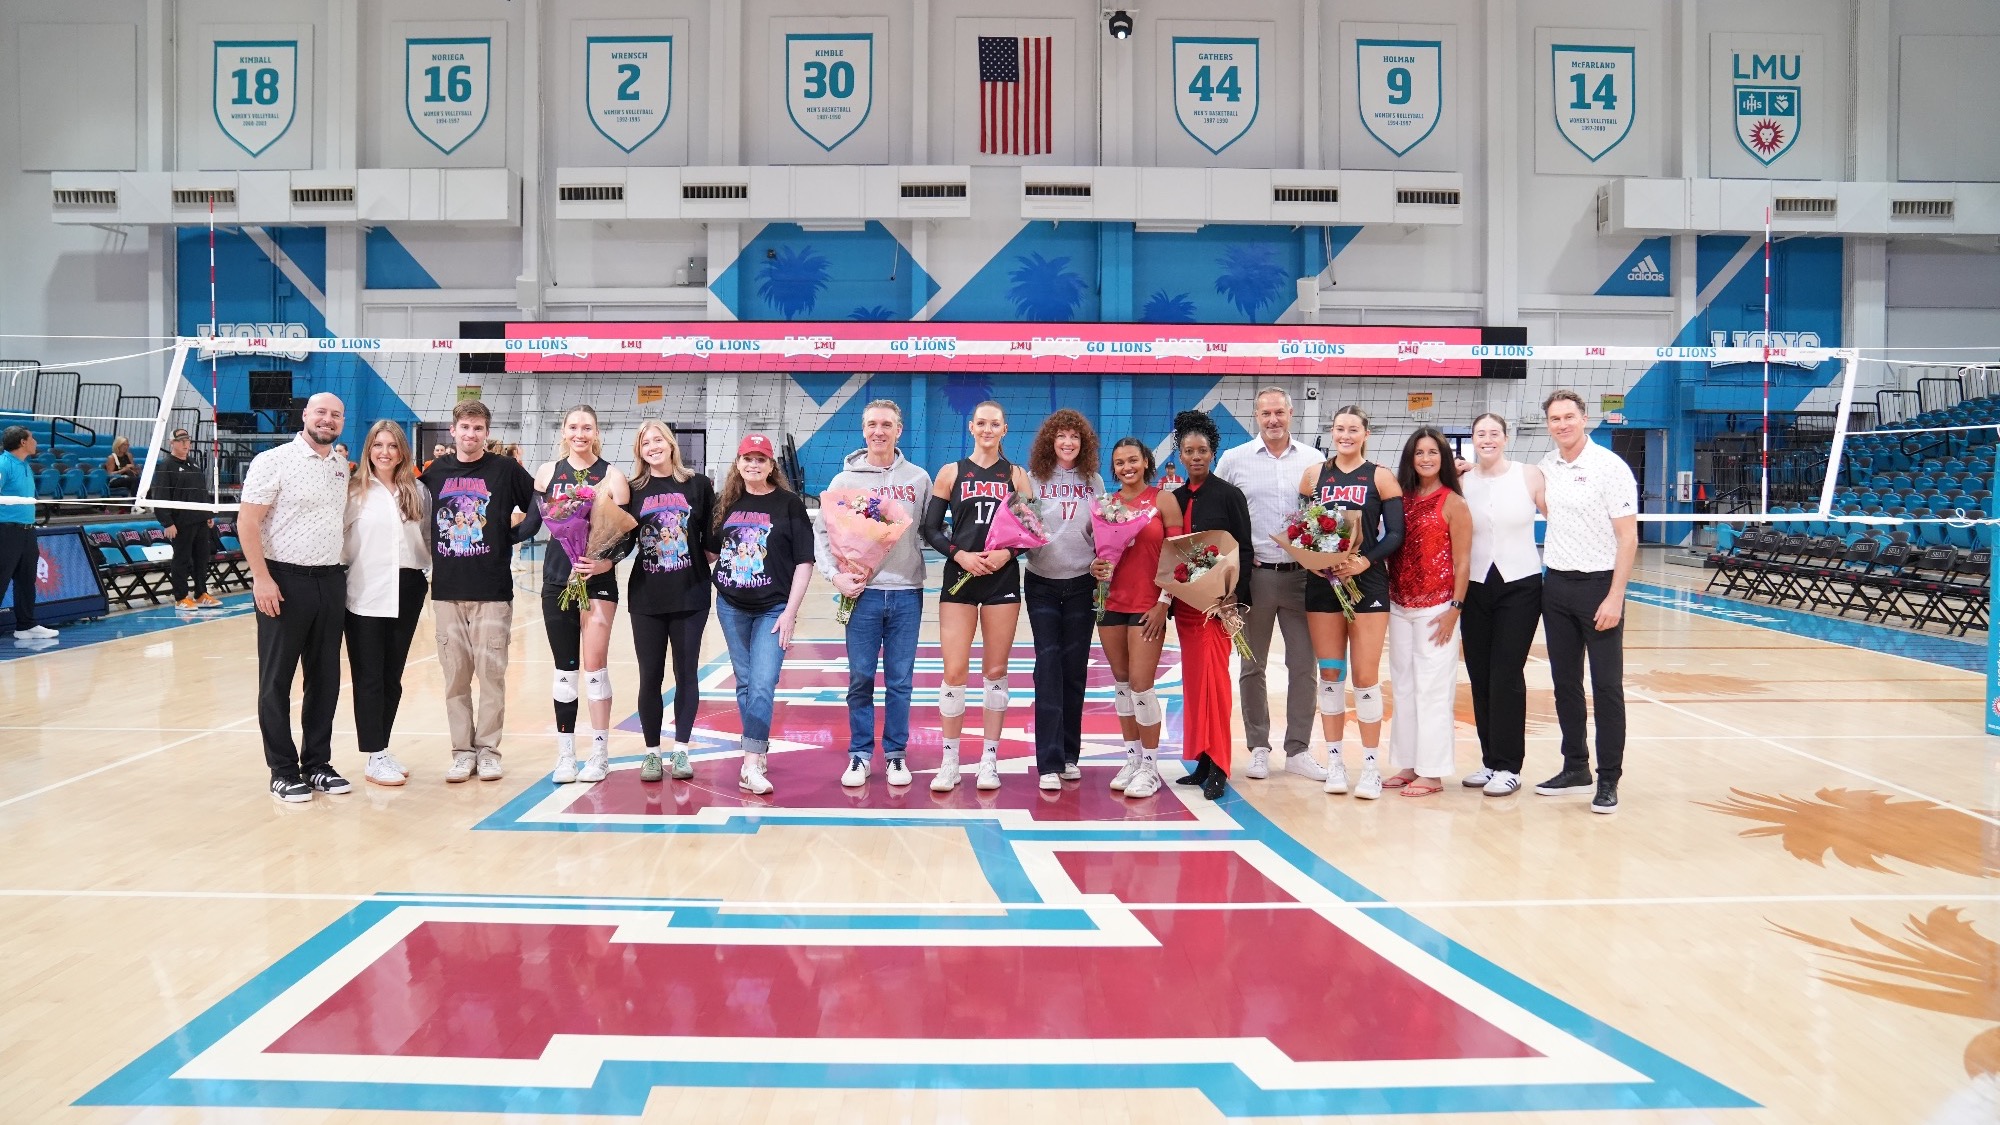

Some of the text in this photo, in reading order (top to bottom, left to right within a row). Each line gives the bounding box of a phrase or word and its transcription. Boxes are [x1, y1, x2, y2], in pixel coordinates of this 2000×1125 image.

[432, 53, 465, 62] NORIEGA
[611, 52, 648, 60] WRENSCH
[815, 49, 844, 57] KIMBLE
[1198, 53, 1233, 61] GATHERS
[1383, 55, 1415, 64] HOLMAN
[1571, 60, 1616, 69] McFARLAND
[1733, 53, 1801, 81] LMU
[424, 65, 472, 103] 16
[617, 63, 641, 101] 2
[803, 61, 855, 99] 30
[1188, 65, 1242, 102] 44
[231, 68, 279, 105] 18
[1386, 67, 1412, 105] 9
[1569, 73, 1618, 110] 14
[1209, 110, 1239, 118] BASKETBALL
[1627, 271, 1665, 281] adidas
[248, 338, 268, 348] LMU
[318, 338, 381, 350] GO LIONS
[432, 340, 453, 349] LMU
[505, 339, 523, 350] GO
[528, 339, 568, 350] LIONS
[621, 340, 642, 349] LMU
[695, 340, 714, 351] GO
[720, 340, 760, 351] LIONS
[814, 341, 836, 350] LMU
[890, 341, 909, 351] GO
[914, 341, 956, 351] LIONS
[1010, 341, 1032, 351] LMU
[1086, 342, 1105, 353] GO
[1110, 342, 1152, 353] LIONS
[1206, 344, 1228, 352] LMU
[1281, 344, 1299, 354] GO
[1304, 344, 1345, 355] LIONS
[1398, 345, 1419, 355] LMU
[1471, 346, 1534, 357] GO LIONS
[1586, 347, 1606, 356] LMU
[1656, 348, 1717, 358] GO LIONS
[870, 484, 916, 505] ONS
[961, 481, 1009, 502] LMU
[1039, 484, 1094, 501] LIONS
[1320, 485, 1368, 506] LMU
[975, 501, 996, 524] 17
[1060, 501, 1078, 520] 17
[437, 541, 491, 557] The Baddie
[642, 558, 661, 574] The
[717, 570, 773, 588] The Baddie
